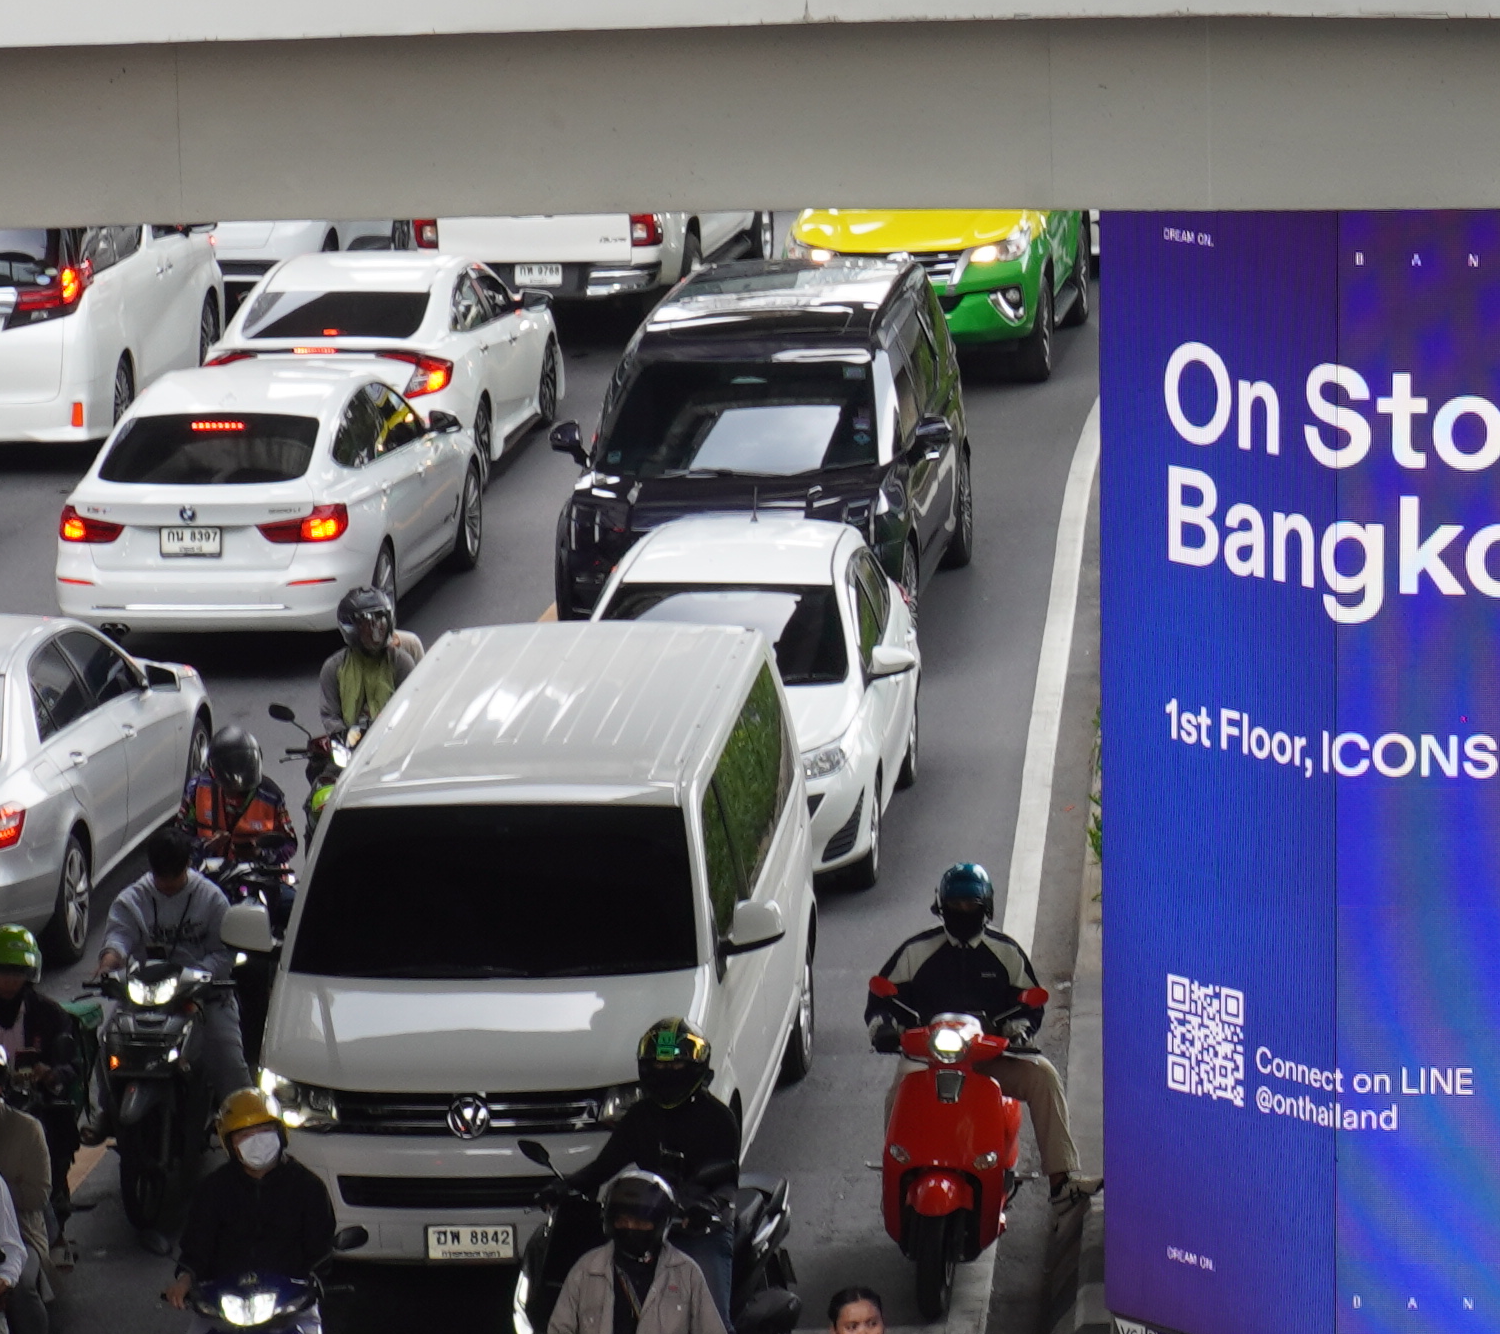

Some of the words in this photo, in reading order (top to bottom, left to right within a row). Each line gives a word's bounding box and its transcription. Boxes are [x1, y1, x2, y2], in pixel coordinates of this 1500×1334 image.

[1163, 341, 1281, 455] On
[1165, 698, 1211, 748] 1st
[1220, 707, 1313, 778] Floor,
[1255, 1045, 1344, 1094] Connect
[1352, 1072, 1391, 1094] on
[1401, 1067, 1474, 1096] LINE
[1255, 1085, 1399, 1131] @onthailand
[470, 1230, 511, 1245] 8842
